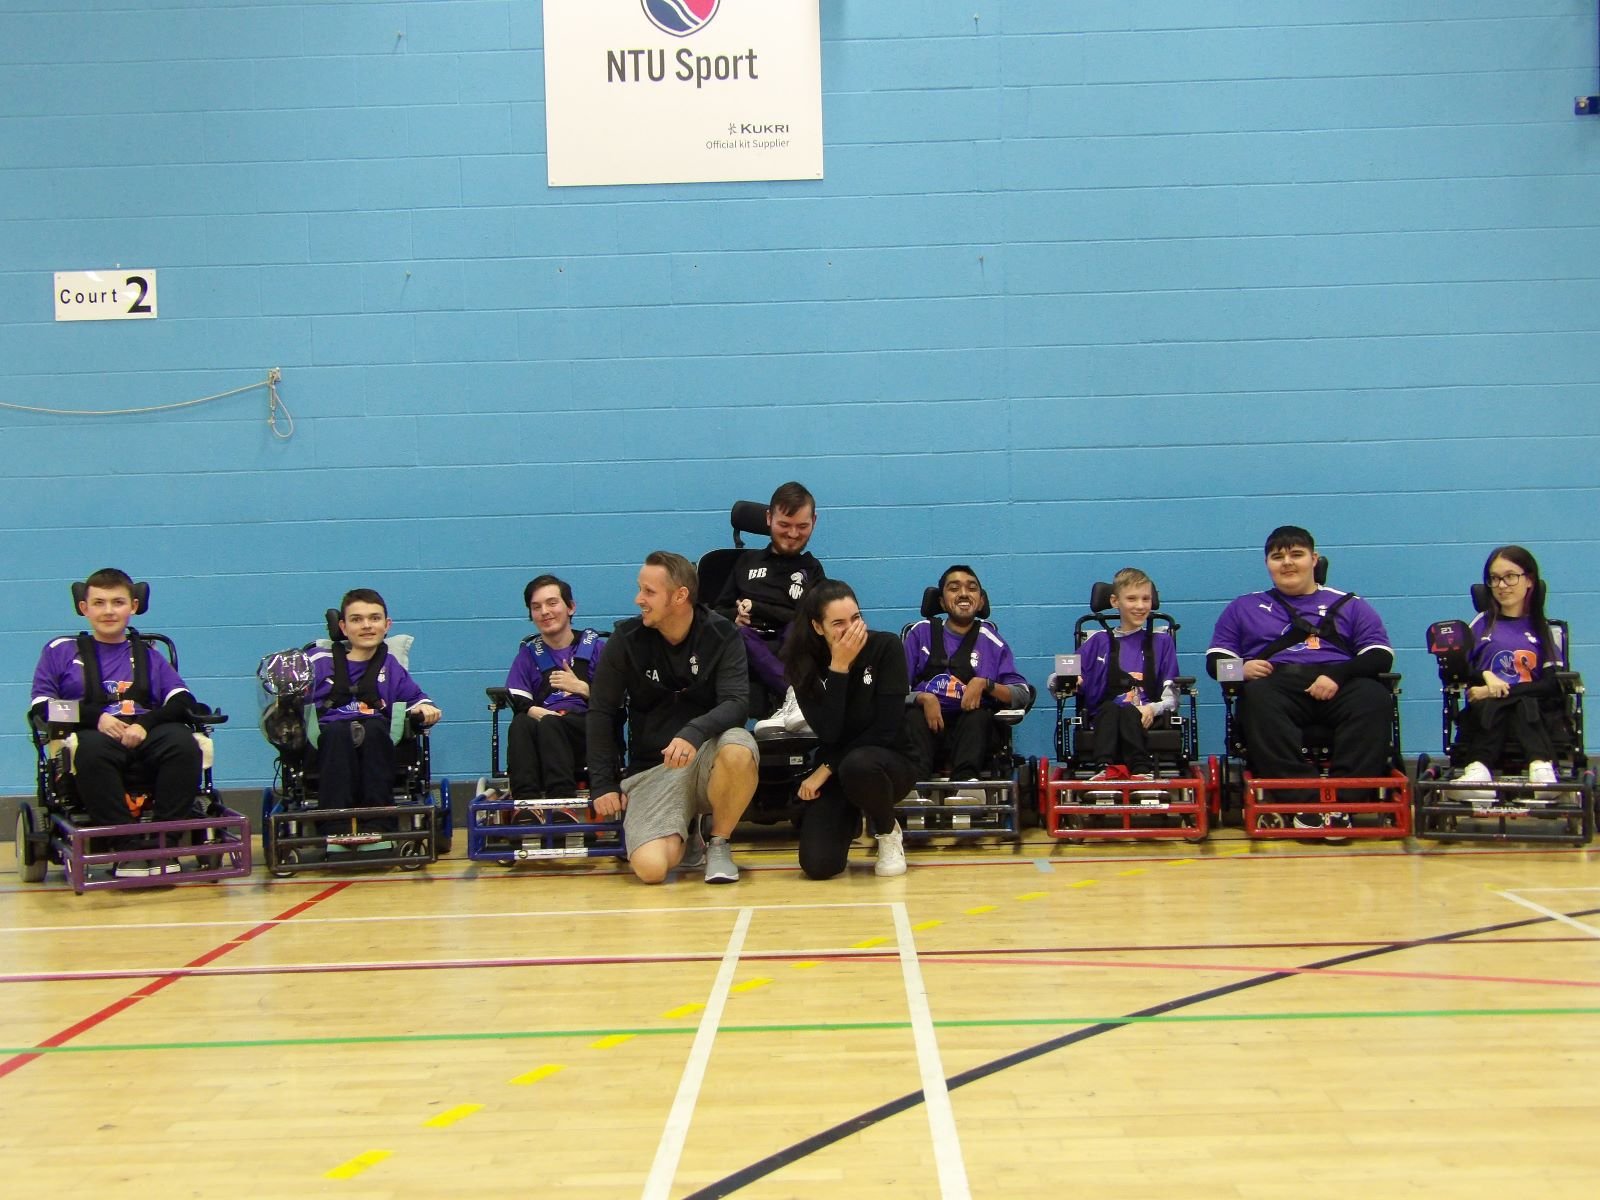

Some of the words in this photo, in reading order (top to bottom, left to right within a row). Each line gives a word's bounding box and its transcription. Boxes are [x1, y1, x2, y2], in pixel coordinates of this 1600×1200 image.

[607, 49, 665, 83] NTU
[675, 48, 759, 89] Sport
[741, 123, 789, 134] KUKRI
[706, 139, 737, 149] Official
[739, 139, 750, 149] kit
[752, 138, 790, 149] Supplier
[60, 288, 118, 304] Court
[126, 276, 152, 314] 2
[1440, 626, 1454, 634] 21
